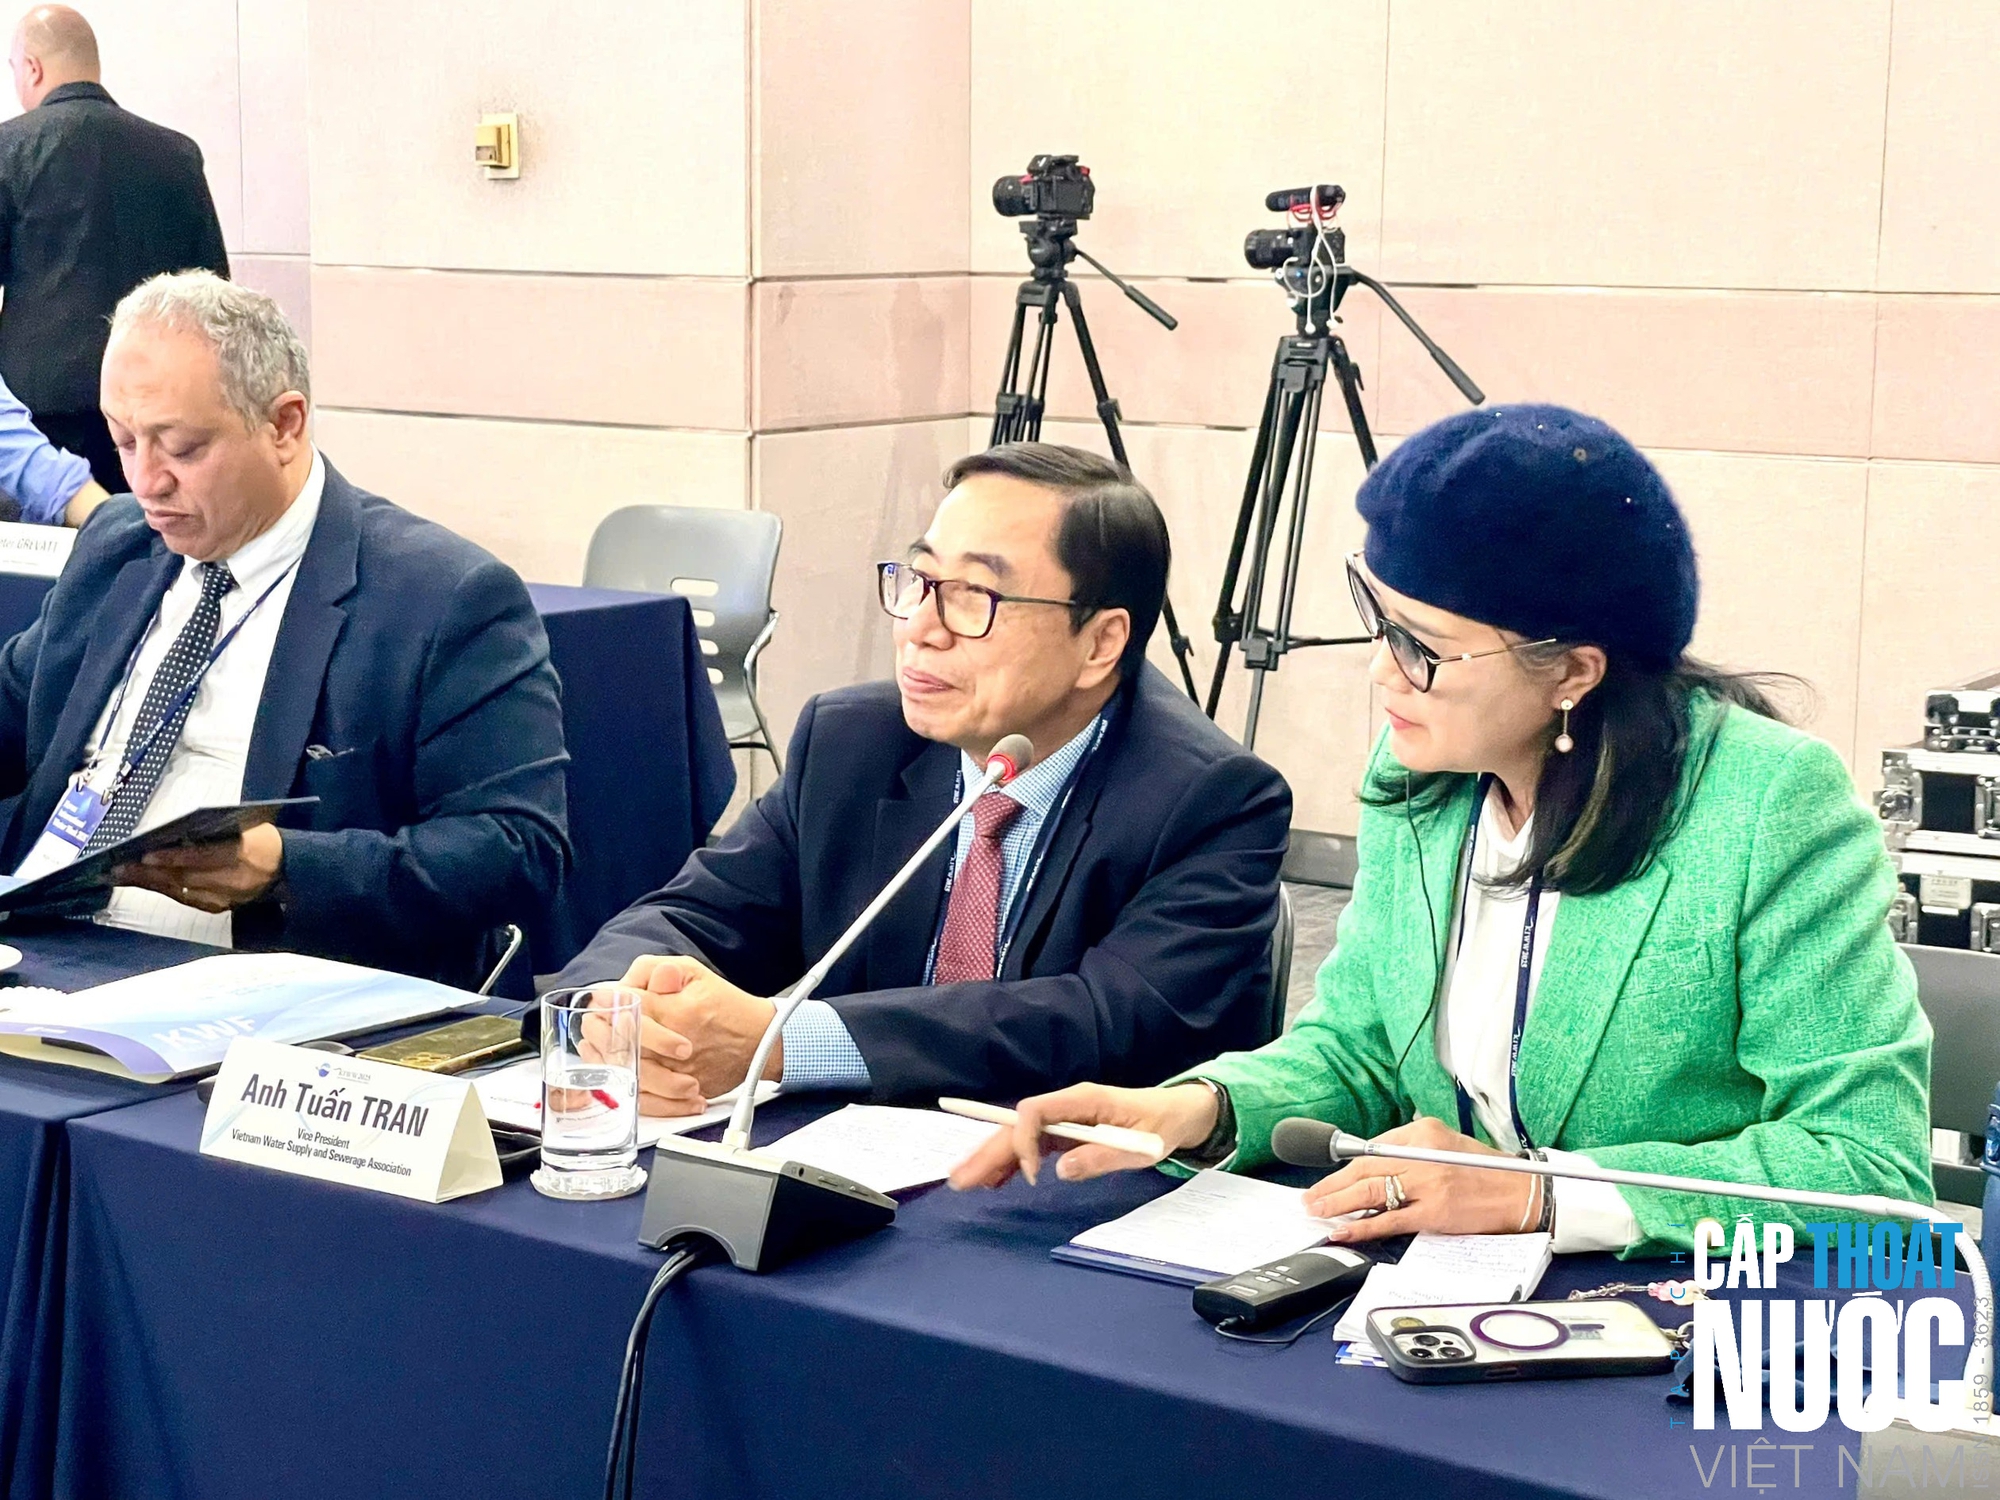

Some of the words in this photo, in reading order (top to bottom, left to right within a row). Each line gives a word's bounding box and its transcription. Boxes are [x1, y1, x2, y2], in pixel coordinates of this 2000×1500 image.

[153, 1015, 256, 1049] KWF
[241, 1074, 288, 1109] Anh
[295, 1082, 353, 1122] Tuấn
[360, 1096, 430, 1137] TRAN
[232, 1128, 262, 1145] Vietnam
[263, 1135, 286, 1150] Water
[287, 1140, 313, 1158] Supply
[313, 1146, 328, 1159] and
[328, 1149, 367, 1169] Sewerage
[367, 1158, 412, 1177] Association
[297, 1127, 314, 1141] Vice
[314, 1131, 350, 1150] President
